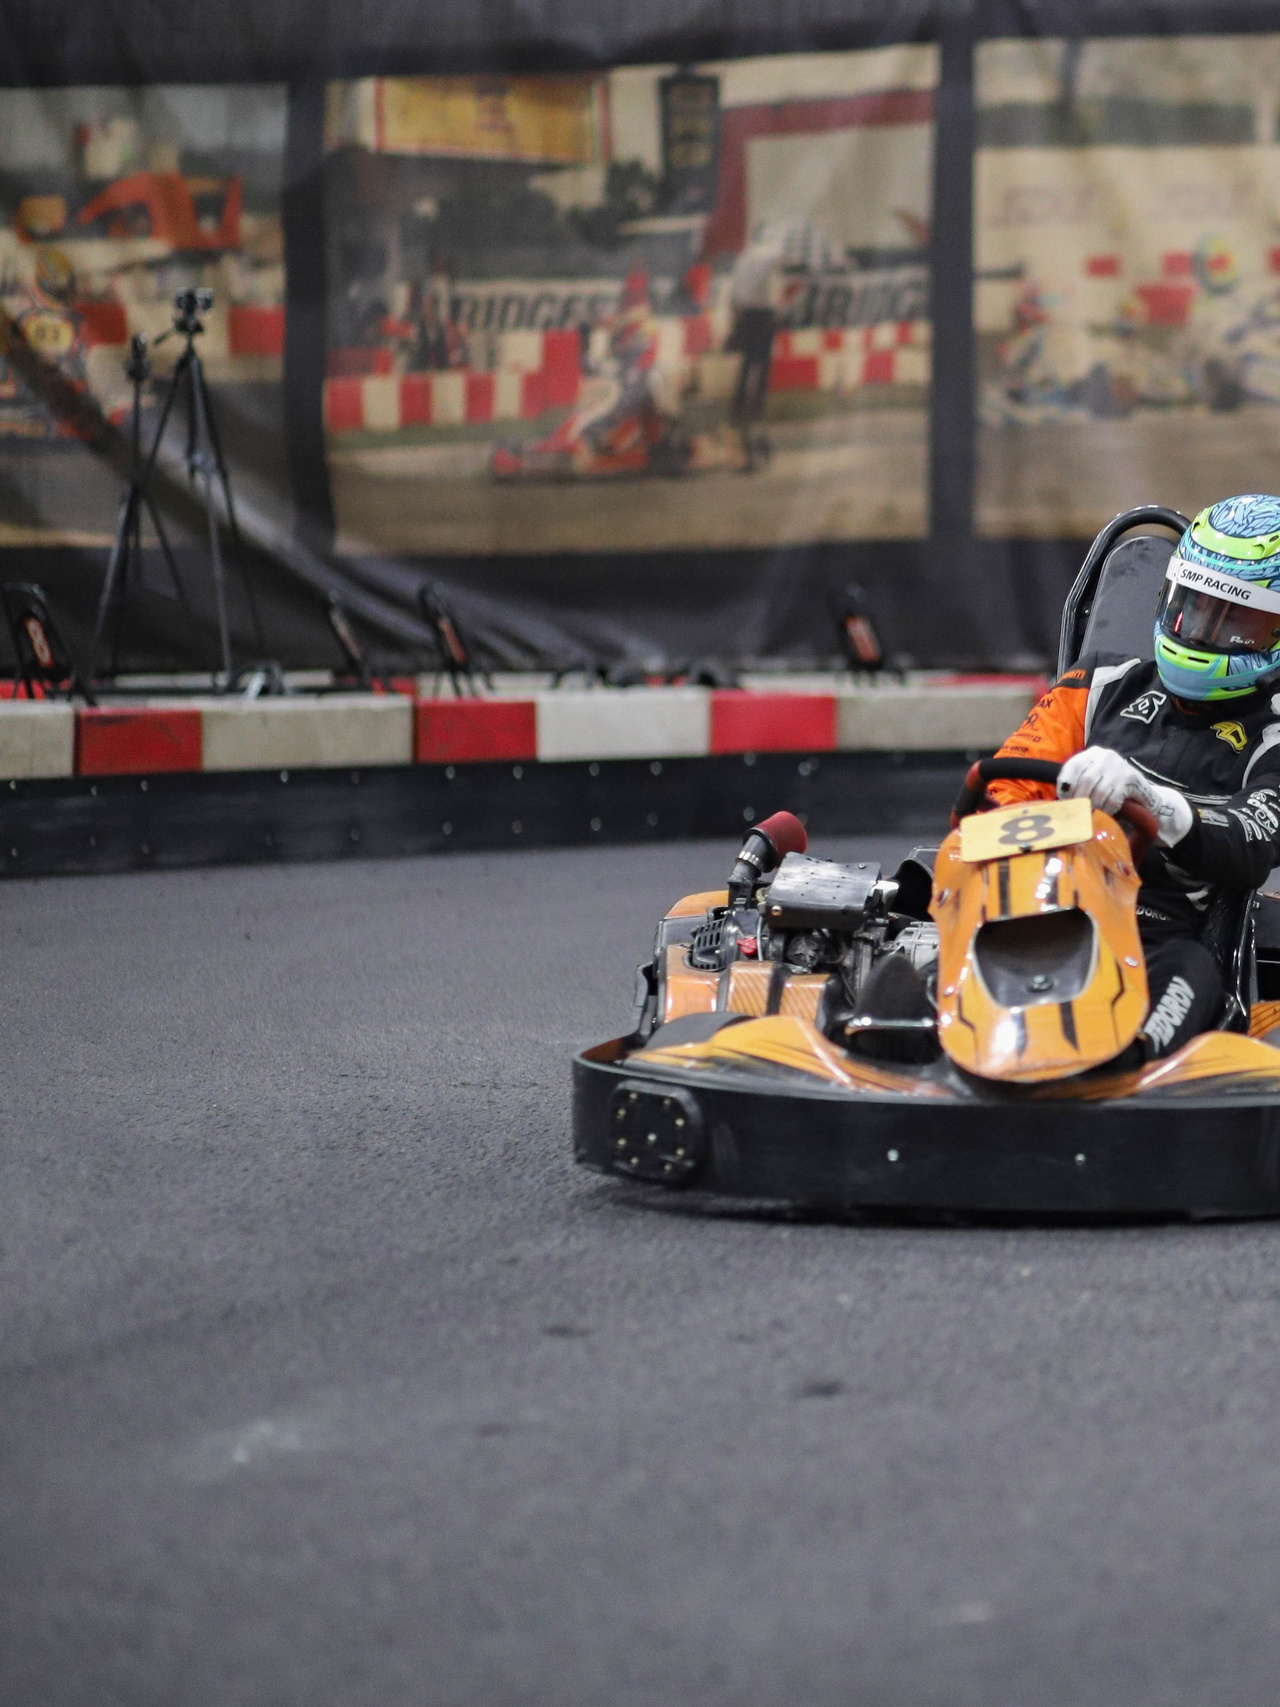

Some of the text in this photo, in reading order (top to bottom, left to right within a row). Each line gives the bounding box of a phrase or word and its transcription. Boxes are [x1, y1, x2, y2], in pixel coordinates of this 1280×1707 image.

[1180, 568, 1252, 601] SMP RACING
[998, 814, 1056, 845] 8
